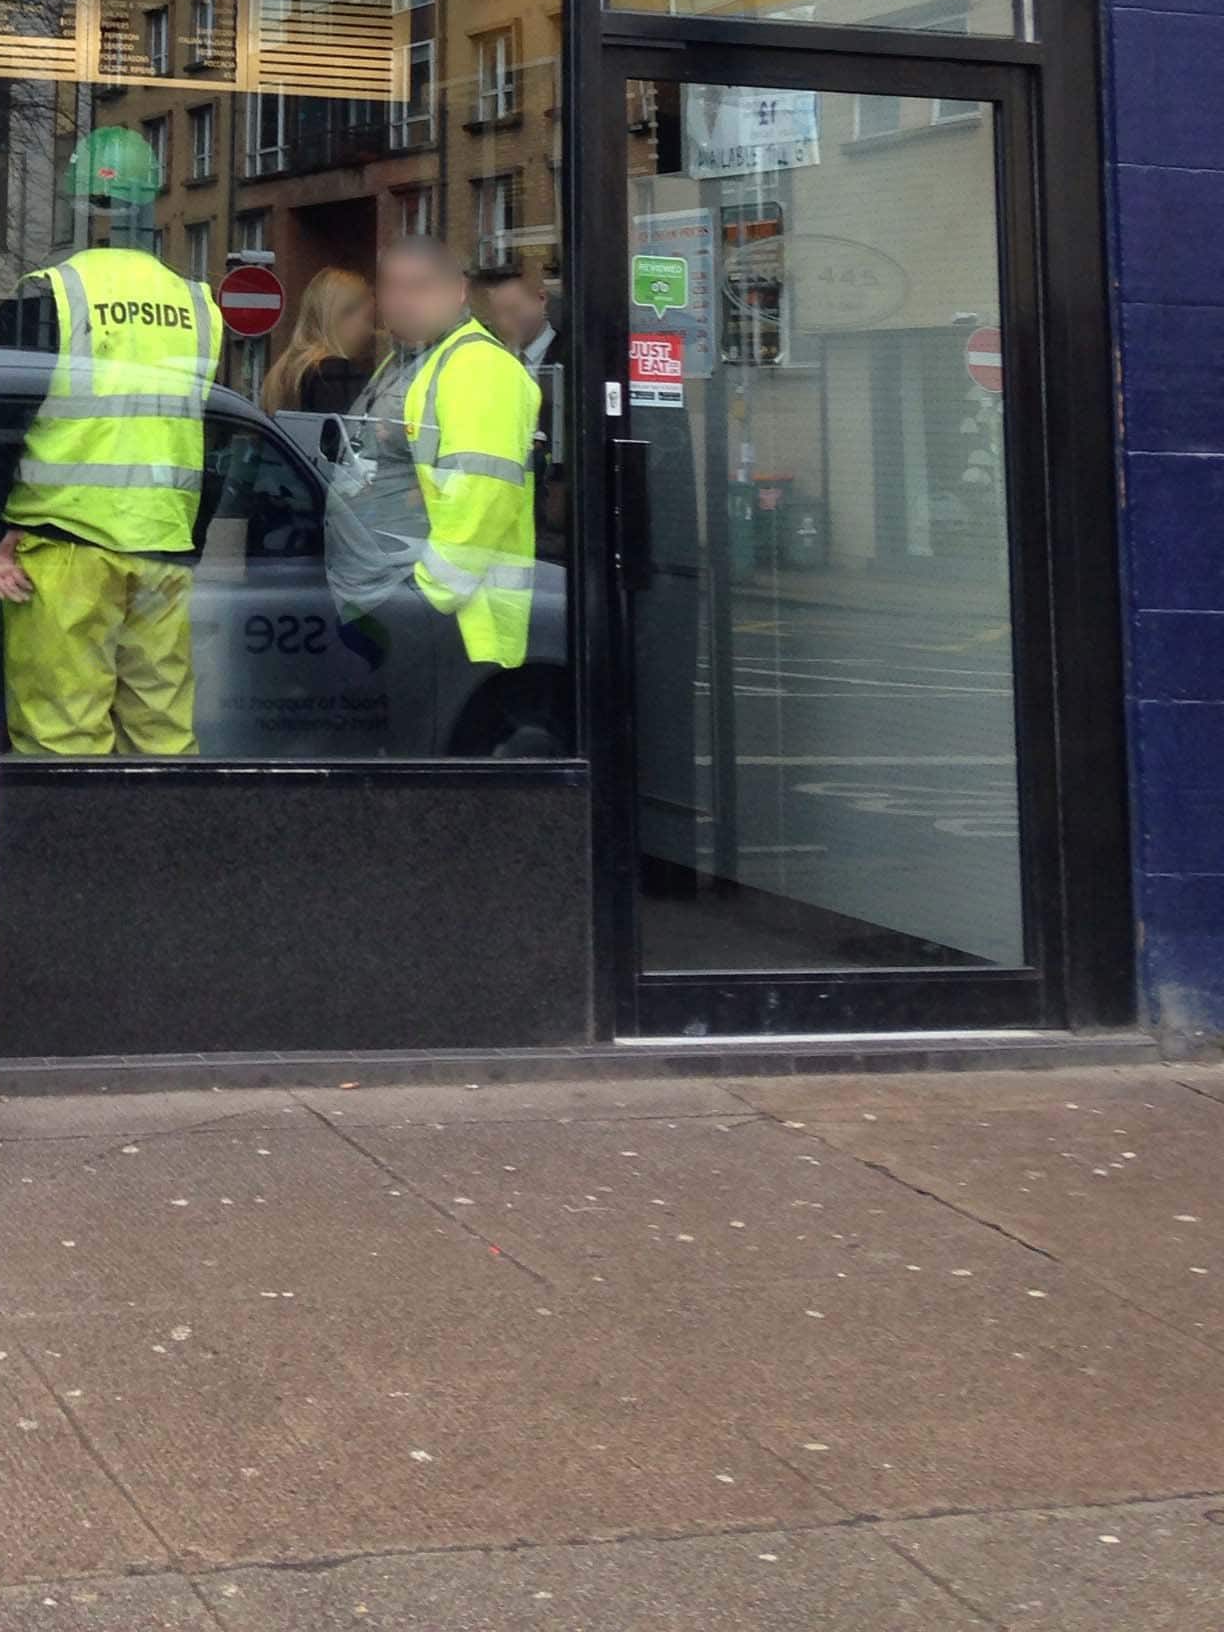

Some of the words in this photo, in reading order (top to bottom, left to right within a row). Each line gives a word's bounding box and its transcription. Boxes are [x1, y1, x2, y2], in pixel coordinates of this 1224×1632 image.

[93, 301, 194, 332] TOPSIDE
[630, 342, 670, 358] JUST
[641, 359, 668, 373] EAT
